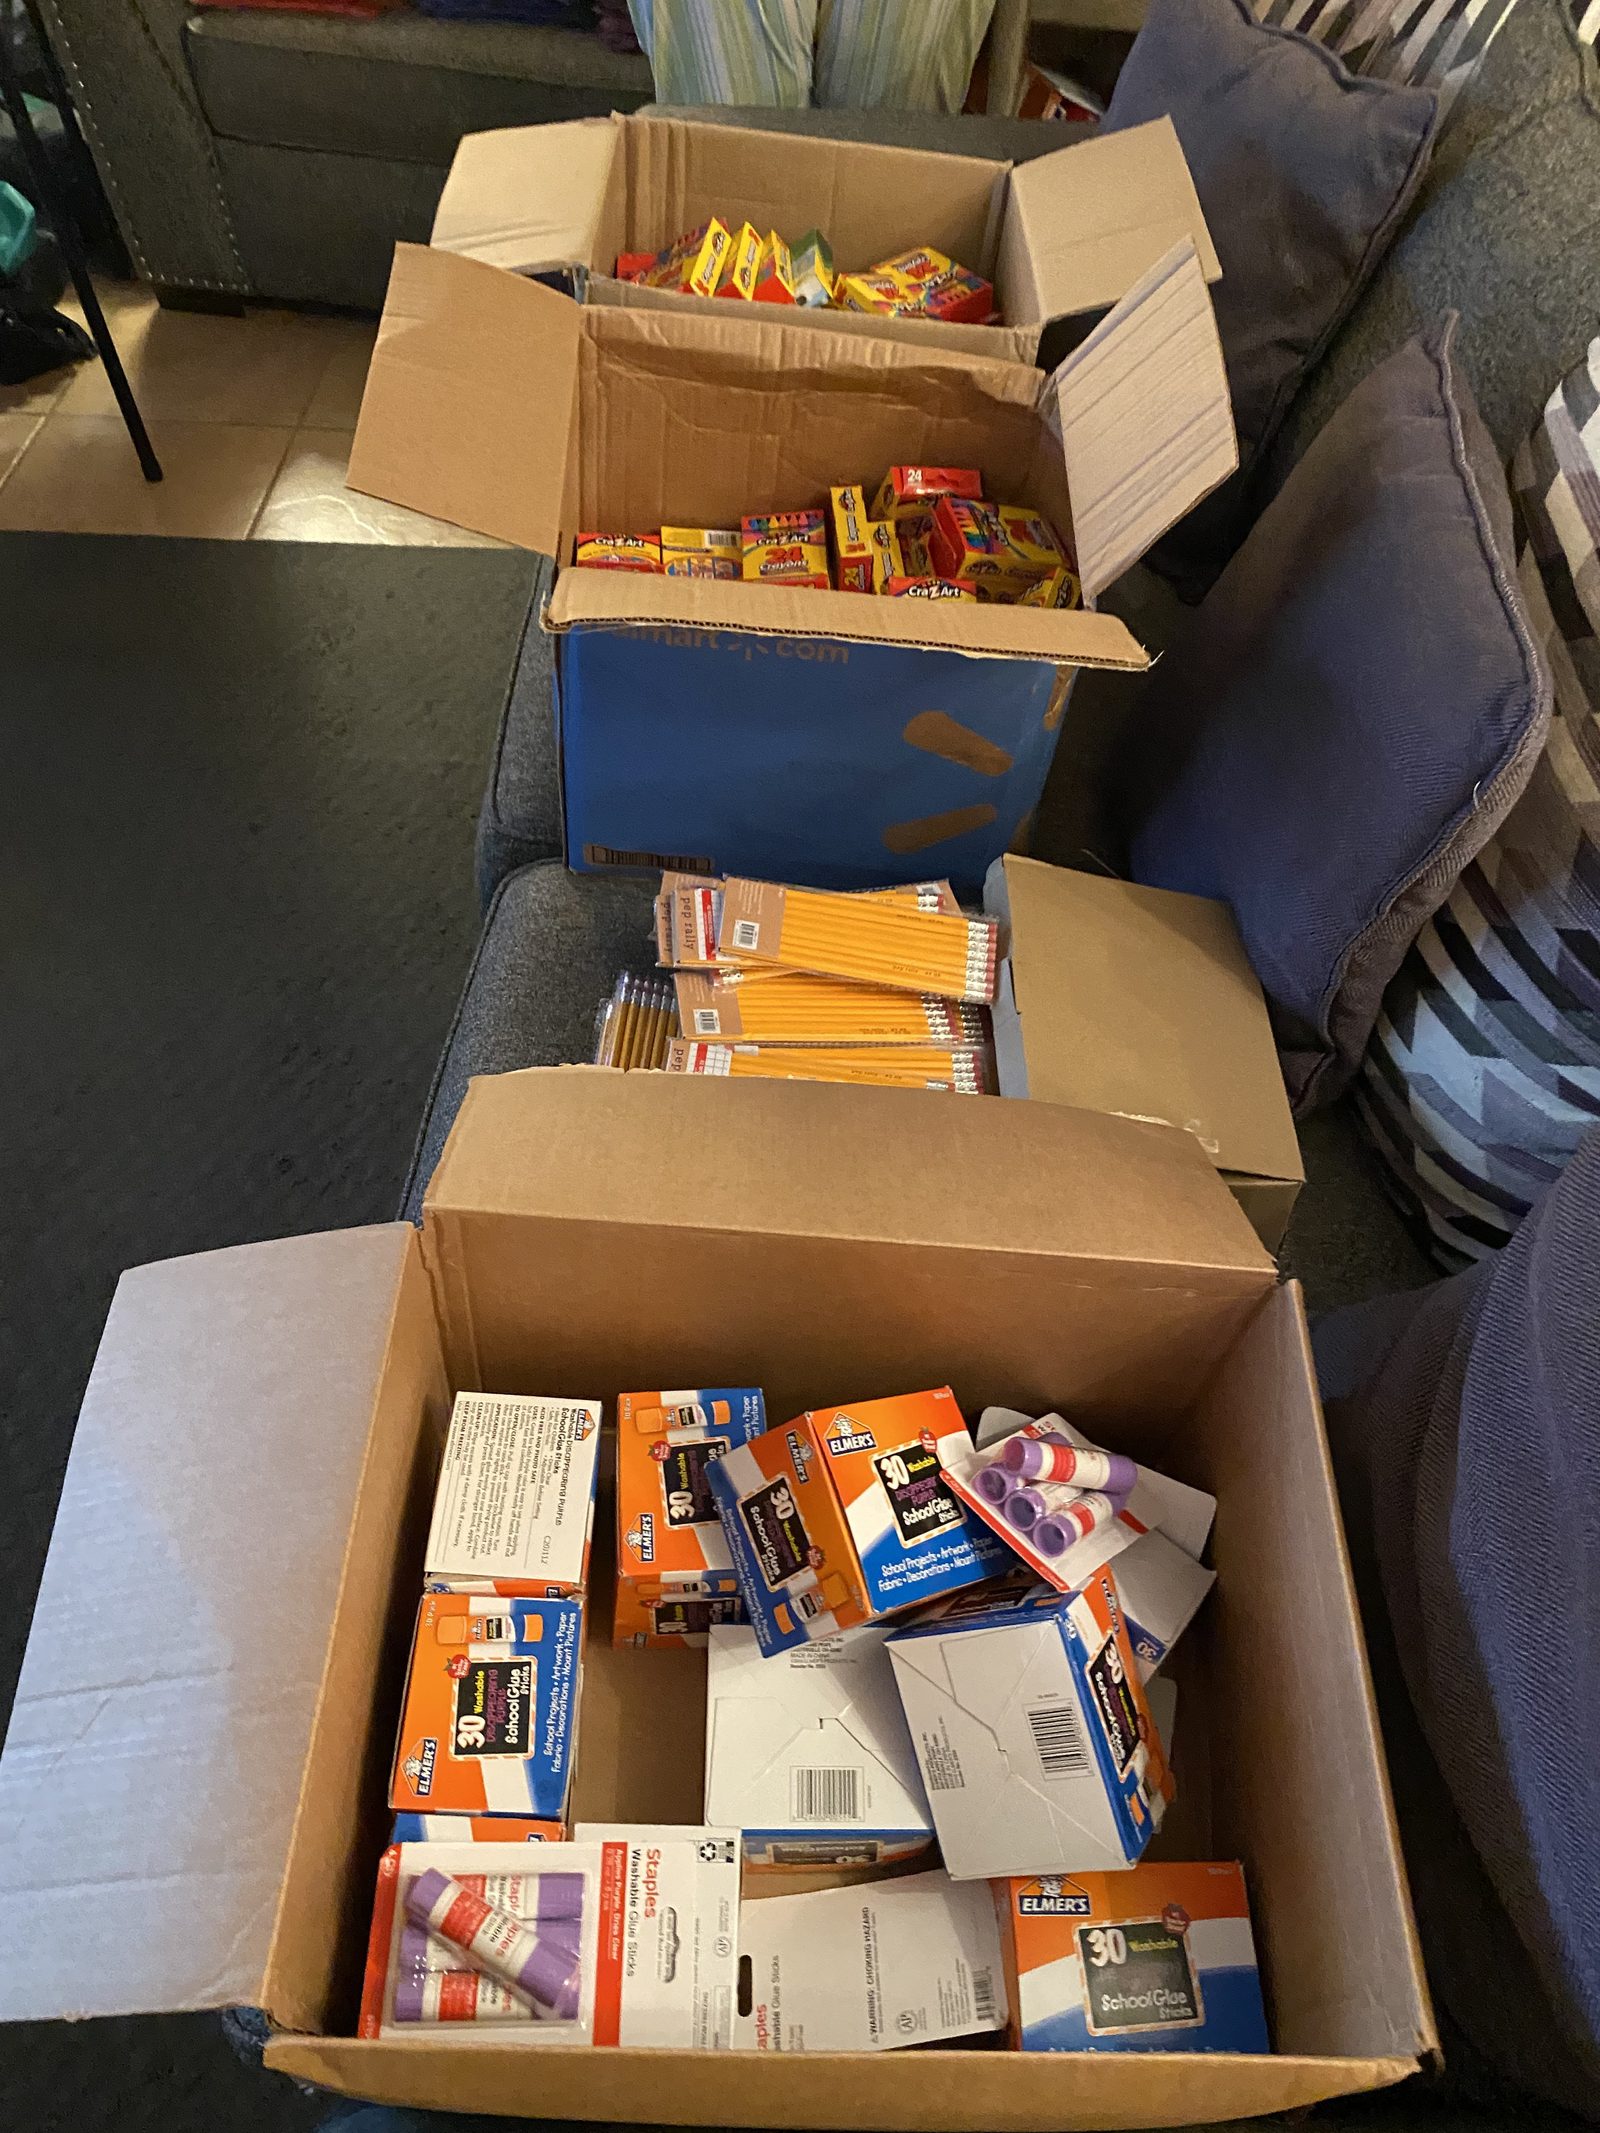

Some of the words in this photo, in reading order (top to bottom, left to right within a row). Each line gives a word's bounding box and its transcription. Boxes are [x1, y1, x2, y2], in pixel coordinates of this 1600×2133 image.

[907, 469, 922, 482] 24
[765, 546, 804, 563] 24
[680, 897, 691, 918] pep
[682, 922, 695, 949] rally
[671, 1048, 683, 1070] pep
[831, 1433, 874, 1453] ELMER'S
[786, 1435, 808, 1482] ELMER'S
[880, 1455, 910, 1489] 30
[669, 1490, 695, 1520] 30
[770, 1487, 794, 1519] 30
[903, 1502, 935, 1526] School
[641, 1514, 652, 1560] ELMER'S
[750, 1505, 771, 1548] School
[766, 1546, 781, 1575] Glue
[881, 1561, 907, 1577] School
[907, 1552, 937, 1572] Projects
[939, 1541, 970, 1558] Artwork
[878, 1577, 902, 1591] Fabric
[907, 1563, 949, 1583] Decorations
[556, 1612, 566, 1637] Paper
[565, 1612, 577, 1646] Pictures
[554, 1644, 563, 1679] Artwork
[563, 1647, 573, 1675] Mount
[507, 1669, 520, 1698] Glue
[519, 1666, 530, 1694] Sticks
[457, 1715, 486, 1748] 30
[473, 1671, 485, 1713] Washable
[505, 1698, 518, 1744] School
[547, 1688, 559, 1725] Projects
[556, 1683, 569, 1736] Decorations
[544, 1725, 554, 1755] School
[418, 1740, 436, 1793] ELMER'S
[551, 1744, 562, 1772] Fabric
[630, 1848, 639, 1907] Washable
[645, 1848, 660, 1919] Staples
[1022, 1897, 1088, 1913] ELMER'S
[627, 1910, 639, 1939] Glue
[625, 1941, 638, 1976] Sticks
[1087, 1929, 1126, 1966] 30
[1129, 1939, 1178, 1952] Washable
[769, 1955, 781, 1983] Sticks
[769, 1985, 781, 2008] Glue
[1101, 1992, 1153, 2011] School
[1154, 1988, 1187, 2005] Glue
[752, 2003, 770, 2049] aples
